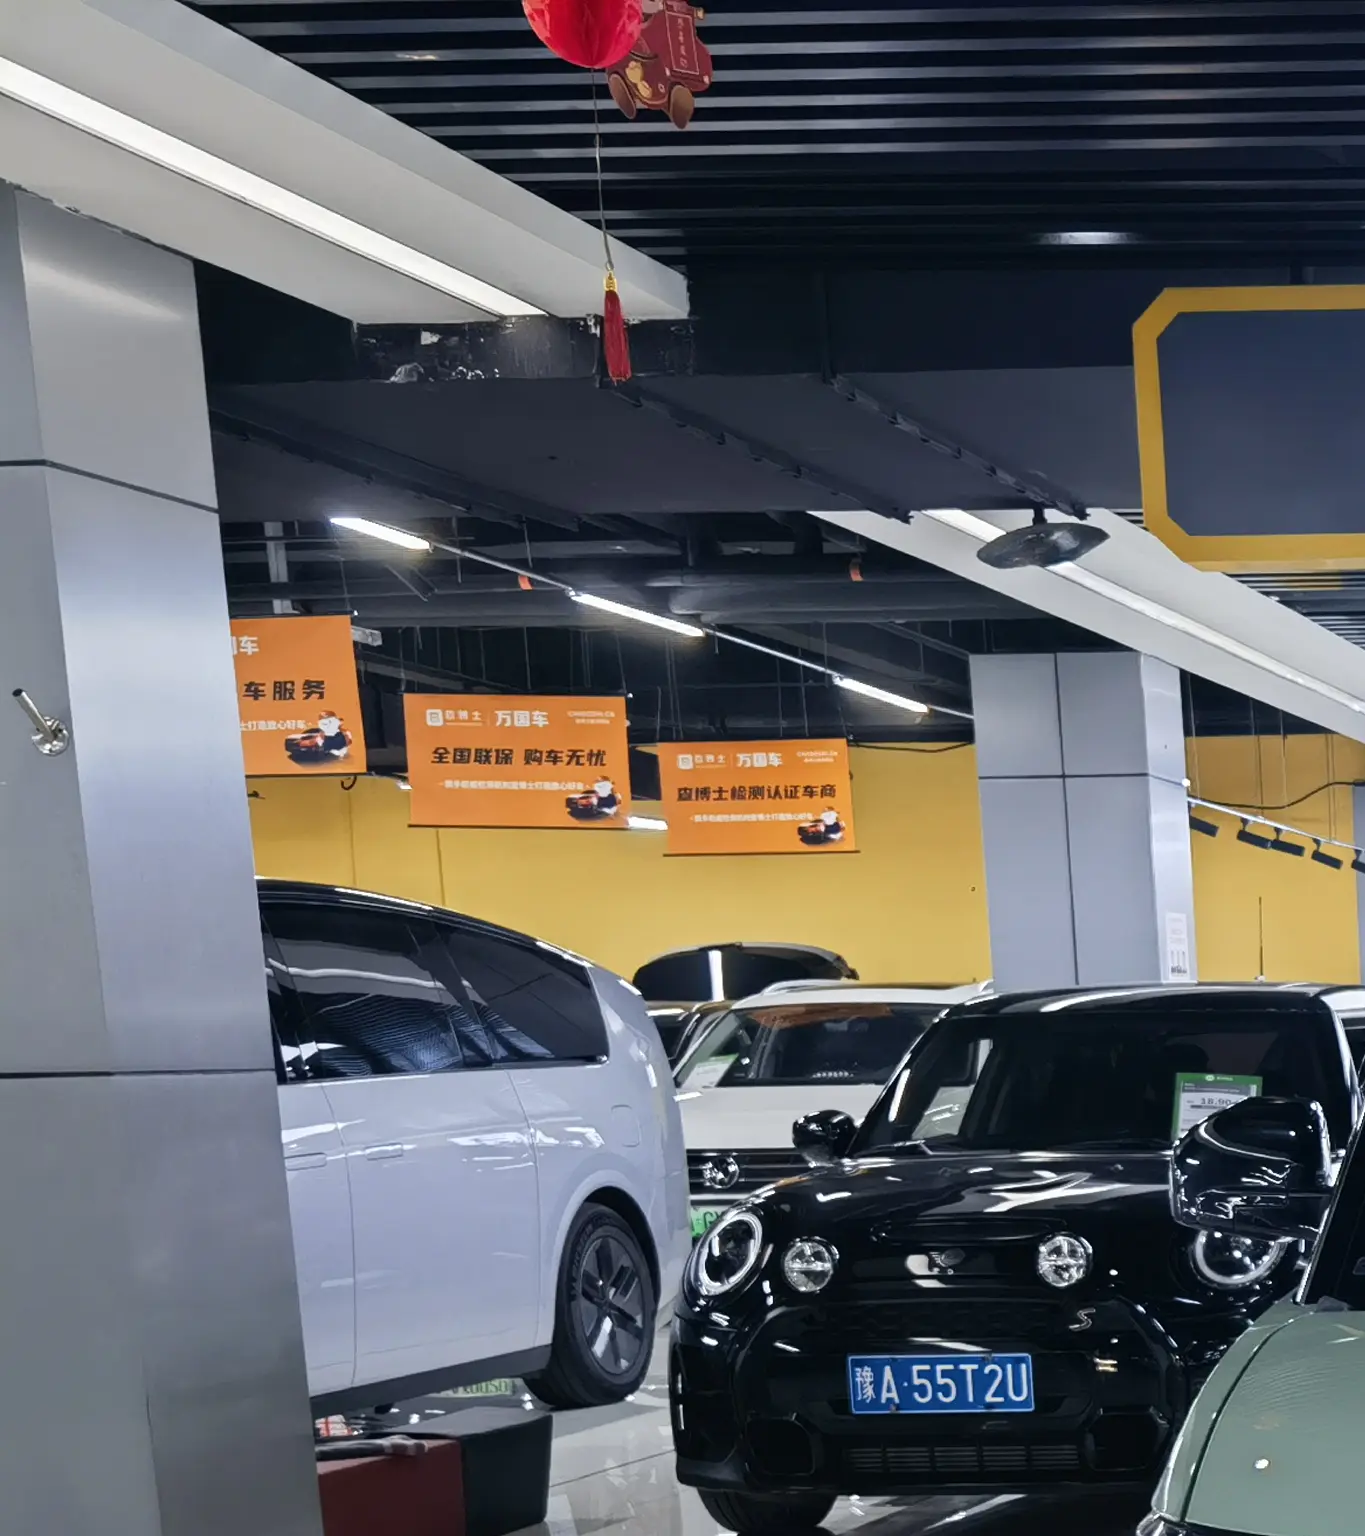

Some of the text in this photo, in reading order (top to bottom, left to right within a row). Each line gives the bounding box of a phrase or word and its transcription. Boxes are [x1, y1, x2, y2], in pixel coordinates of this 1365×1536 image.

[231, 636, 259, 656] 车
[495, 710, 549, 728] 万国车
[431, 747, 607, 767] 全国联保 购车无忧
